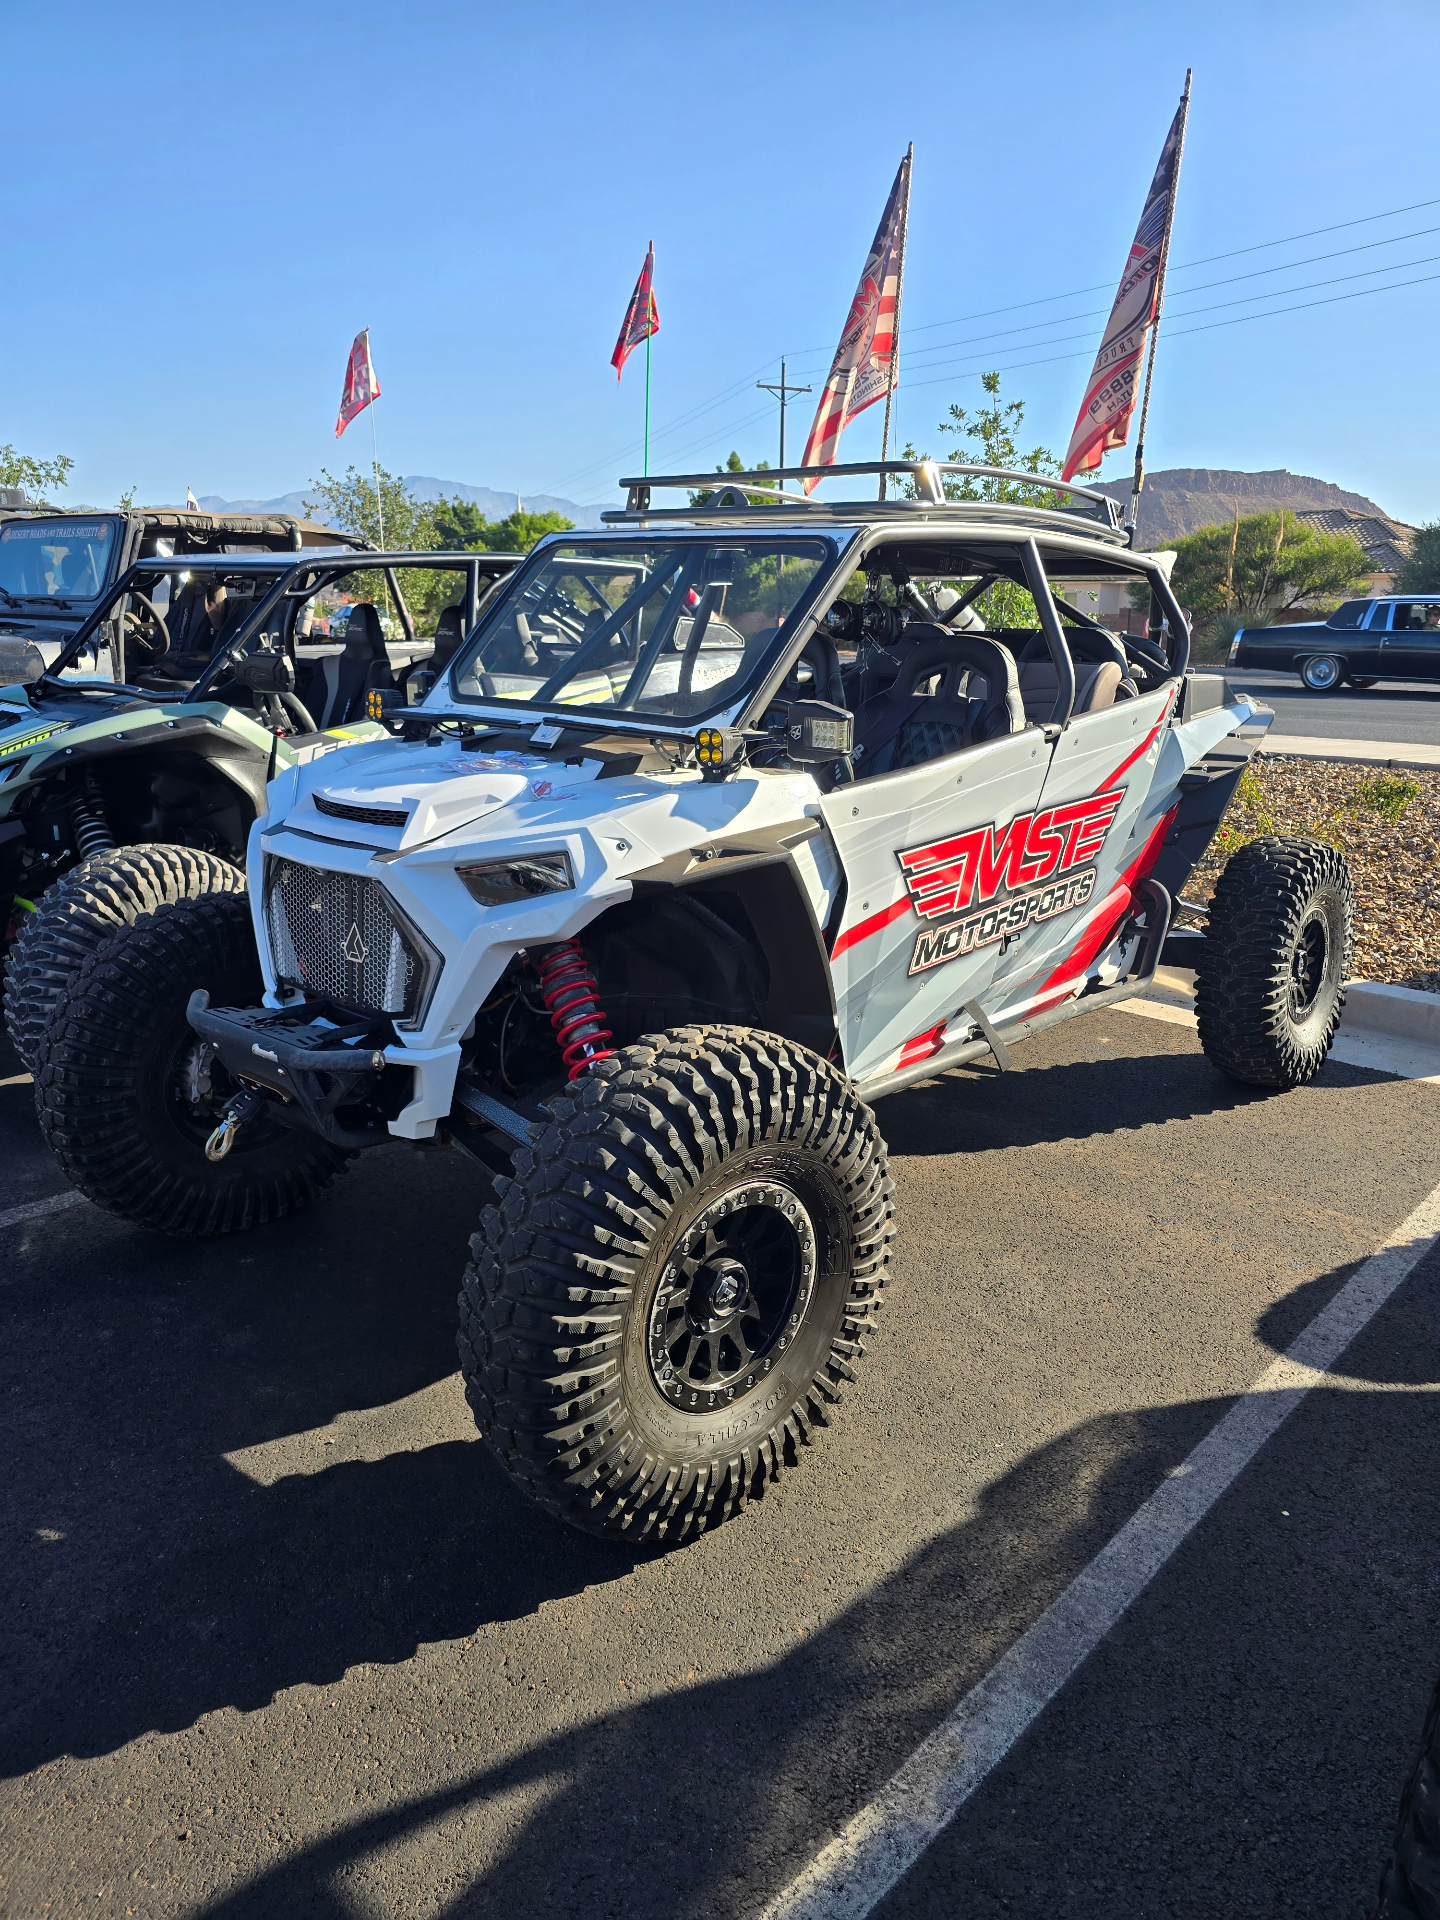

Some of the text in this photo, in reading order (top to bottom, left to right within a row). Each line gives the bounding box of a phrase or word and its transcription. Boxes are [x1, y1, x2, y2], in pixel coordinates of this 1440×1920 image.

[11, 530, 31, 540] DESERT
[29, 529, 47, 539] ROADS
[56, 528, 75, 538] TRAILS
[75, 527, 100, 537] SOCIETY
[894, 786, 1127, 919] MST
[909, 868, 1094, 975] MOTORSPORTS
